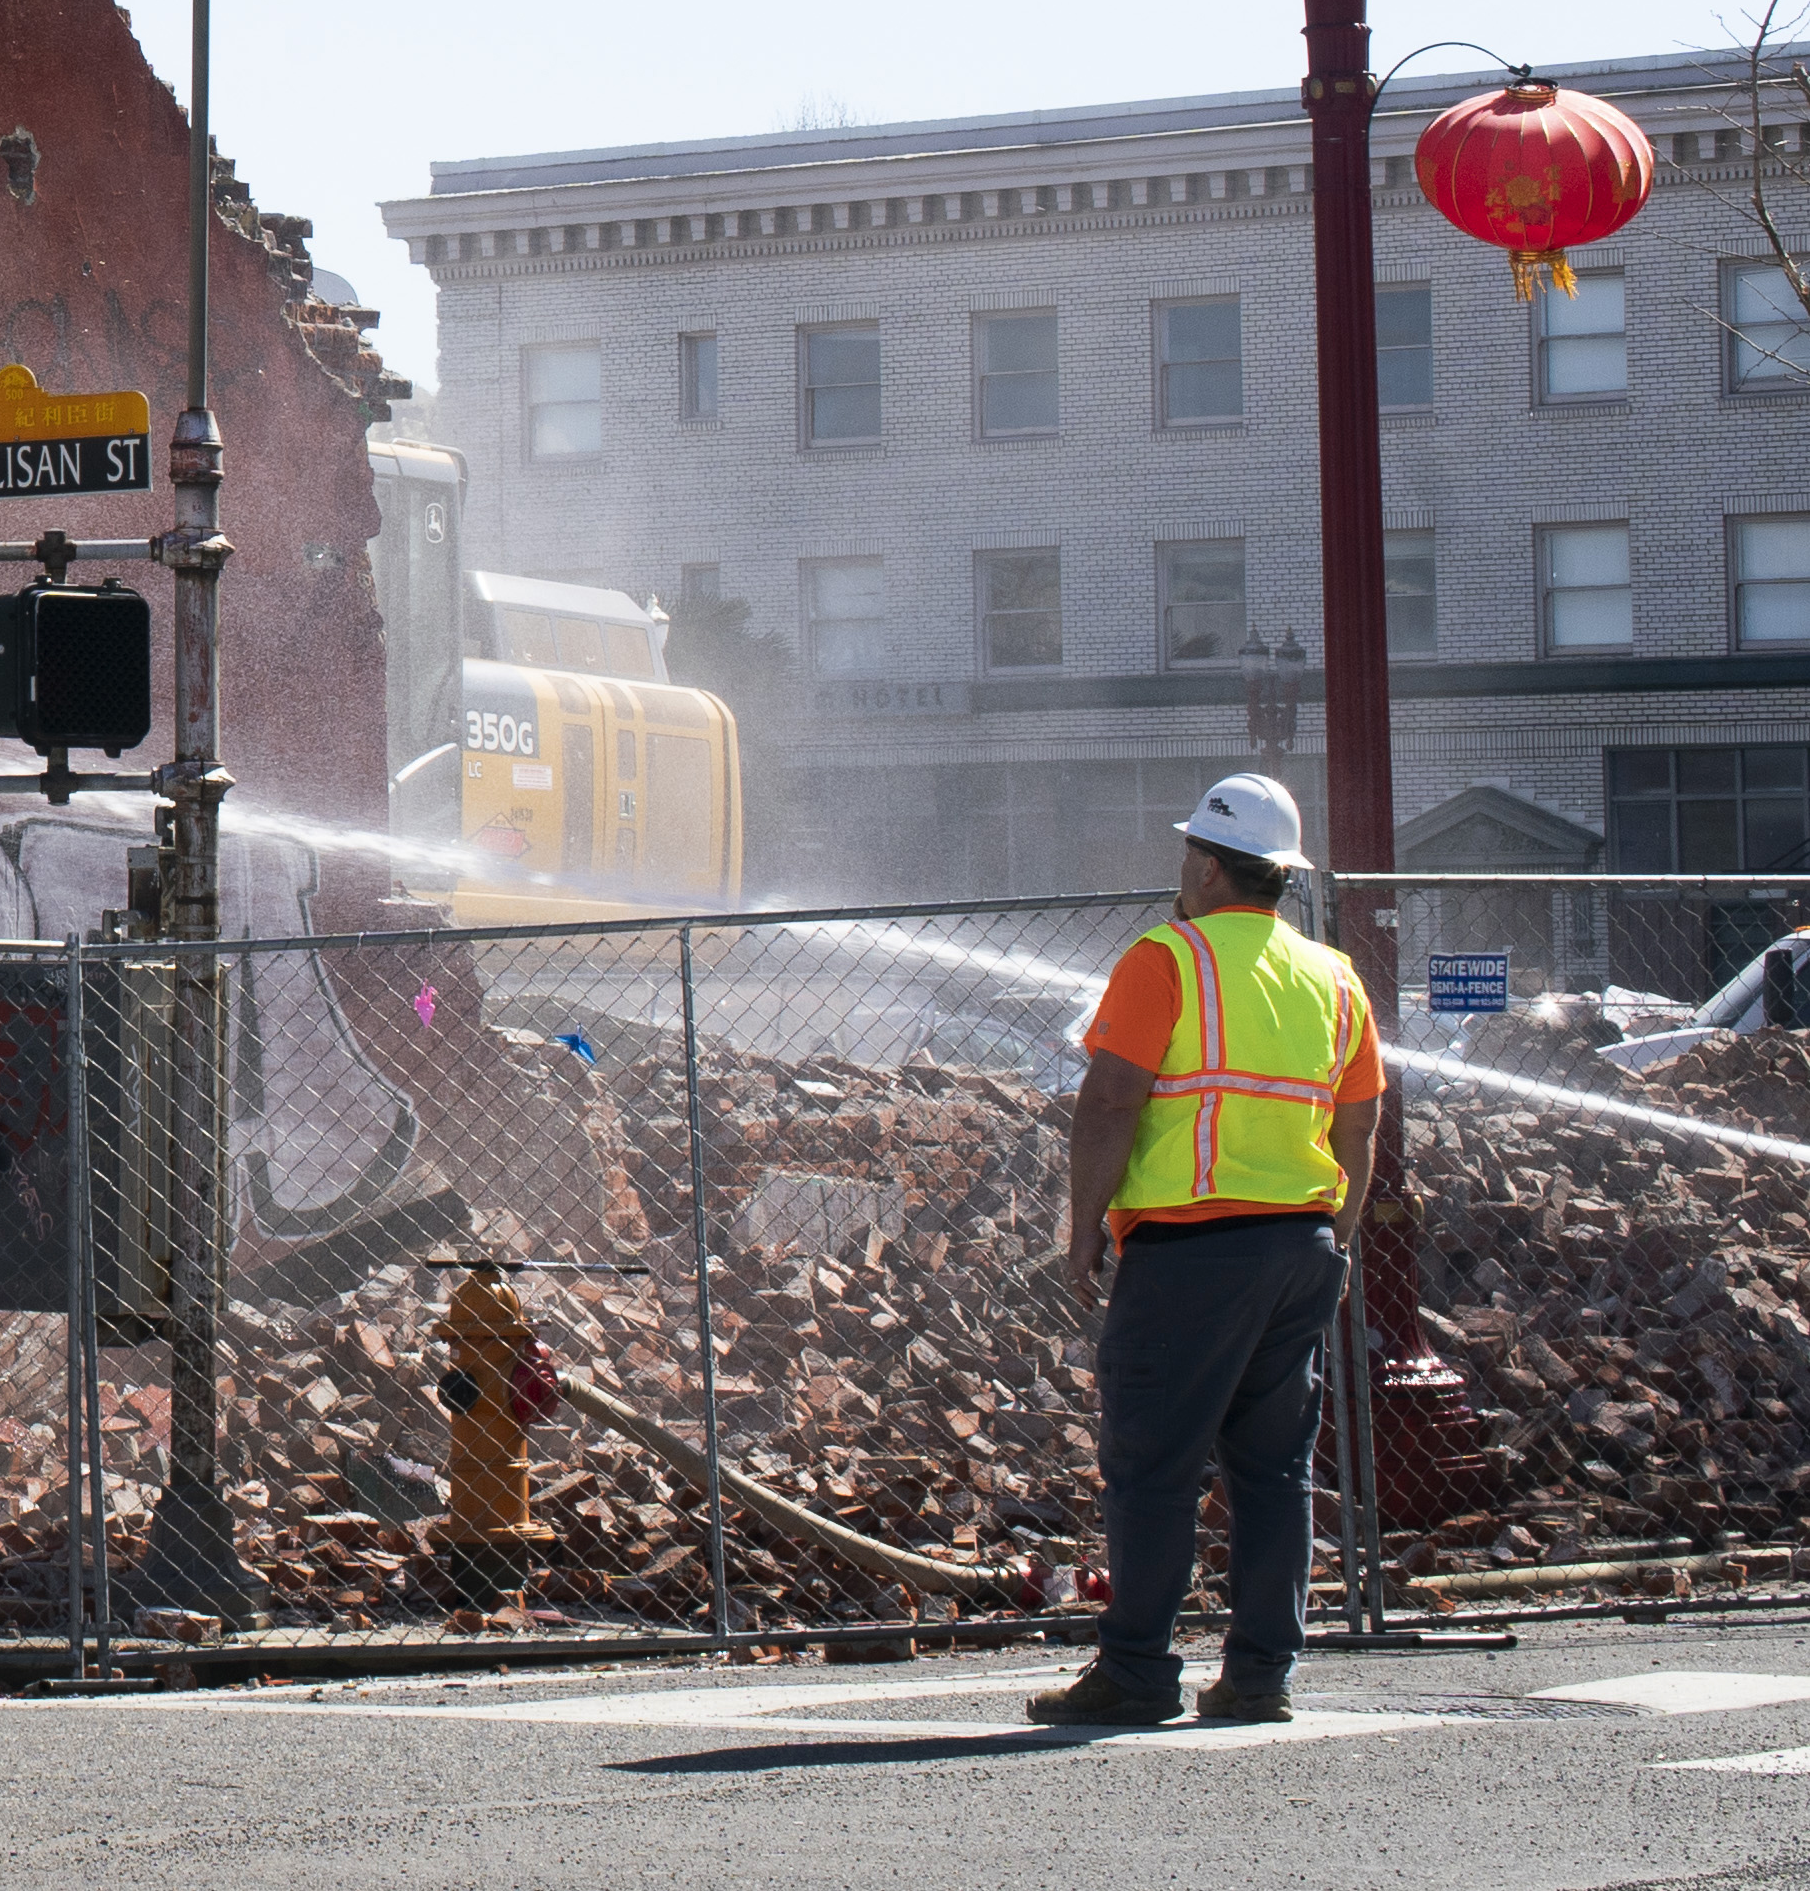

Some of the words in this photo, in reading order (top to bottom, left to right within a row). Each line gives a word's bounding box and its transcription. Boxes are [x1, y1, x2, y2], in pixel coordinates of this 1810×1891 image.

[5, 388, 24, 400] 500
[106, 438, 140, 482] ST
[466, 710, 534, 755] 350G
[468, 761, 482, 778] LC
[1430, 959, 1506, 977] STATEWIDE
[1430, 981, 1504, 995] RENT-A-FENCE
